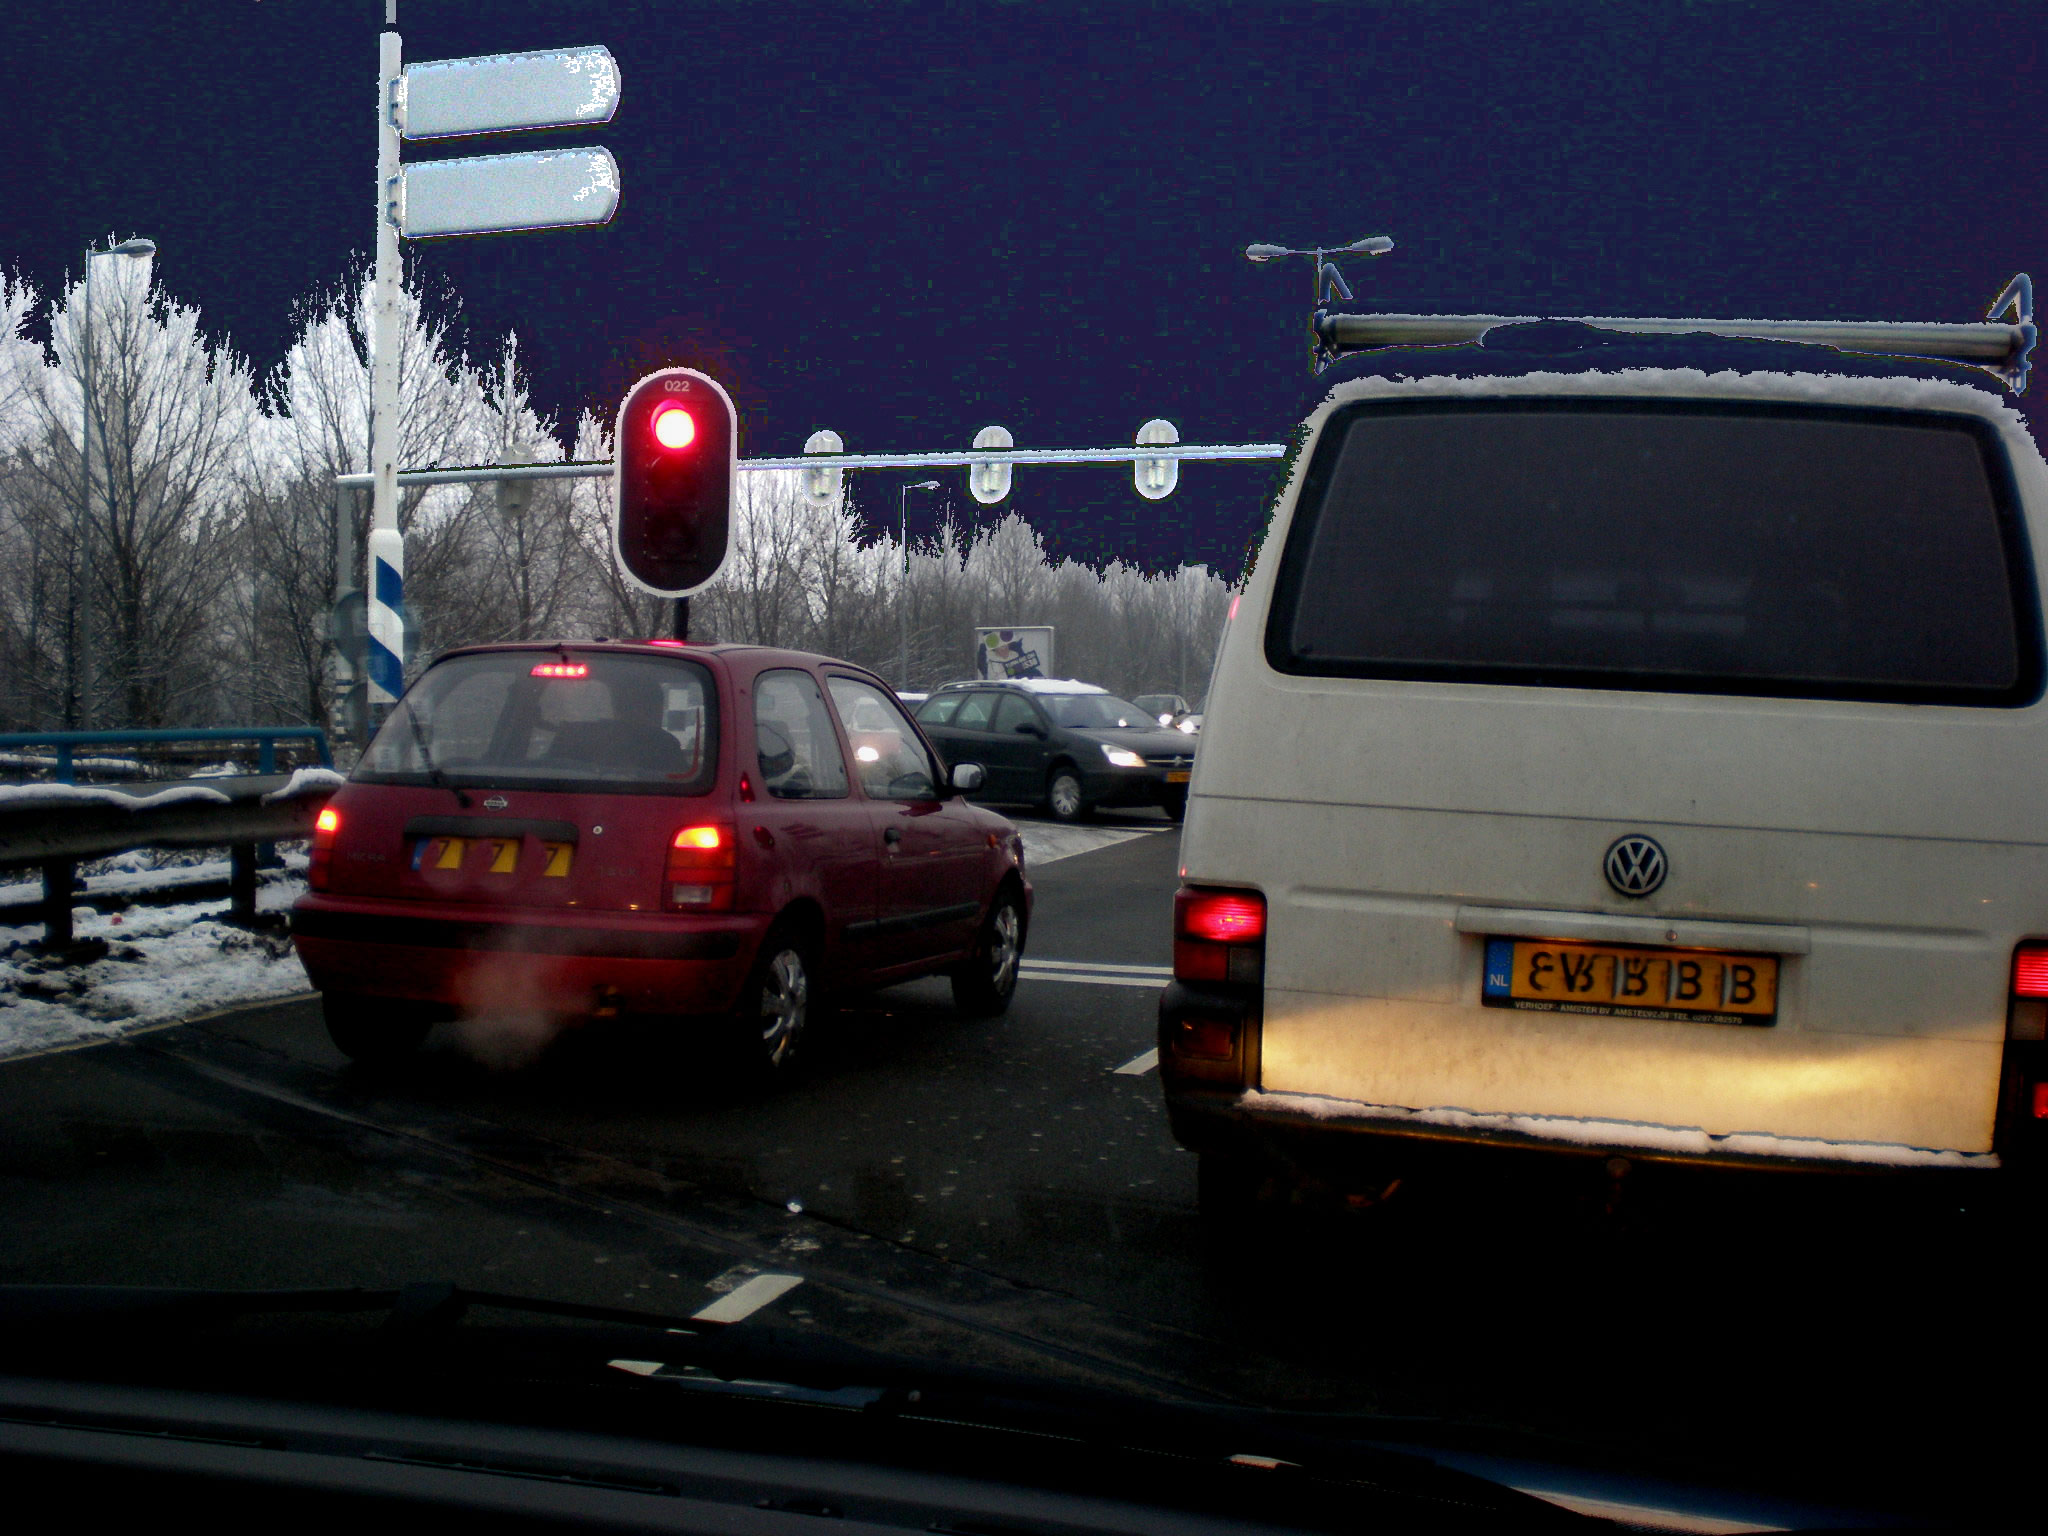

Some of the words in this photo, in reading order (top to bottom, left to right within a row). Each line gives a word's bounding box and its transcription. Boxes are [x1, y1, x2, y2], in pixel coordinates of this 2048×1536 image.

[664, 380, 690, 392] 022
[1489, 973, 1509, 987] NL
[1515, 1001, 1554, 1011] VERHOEF
